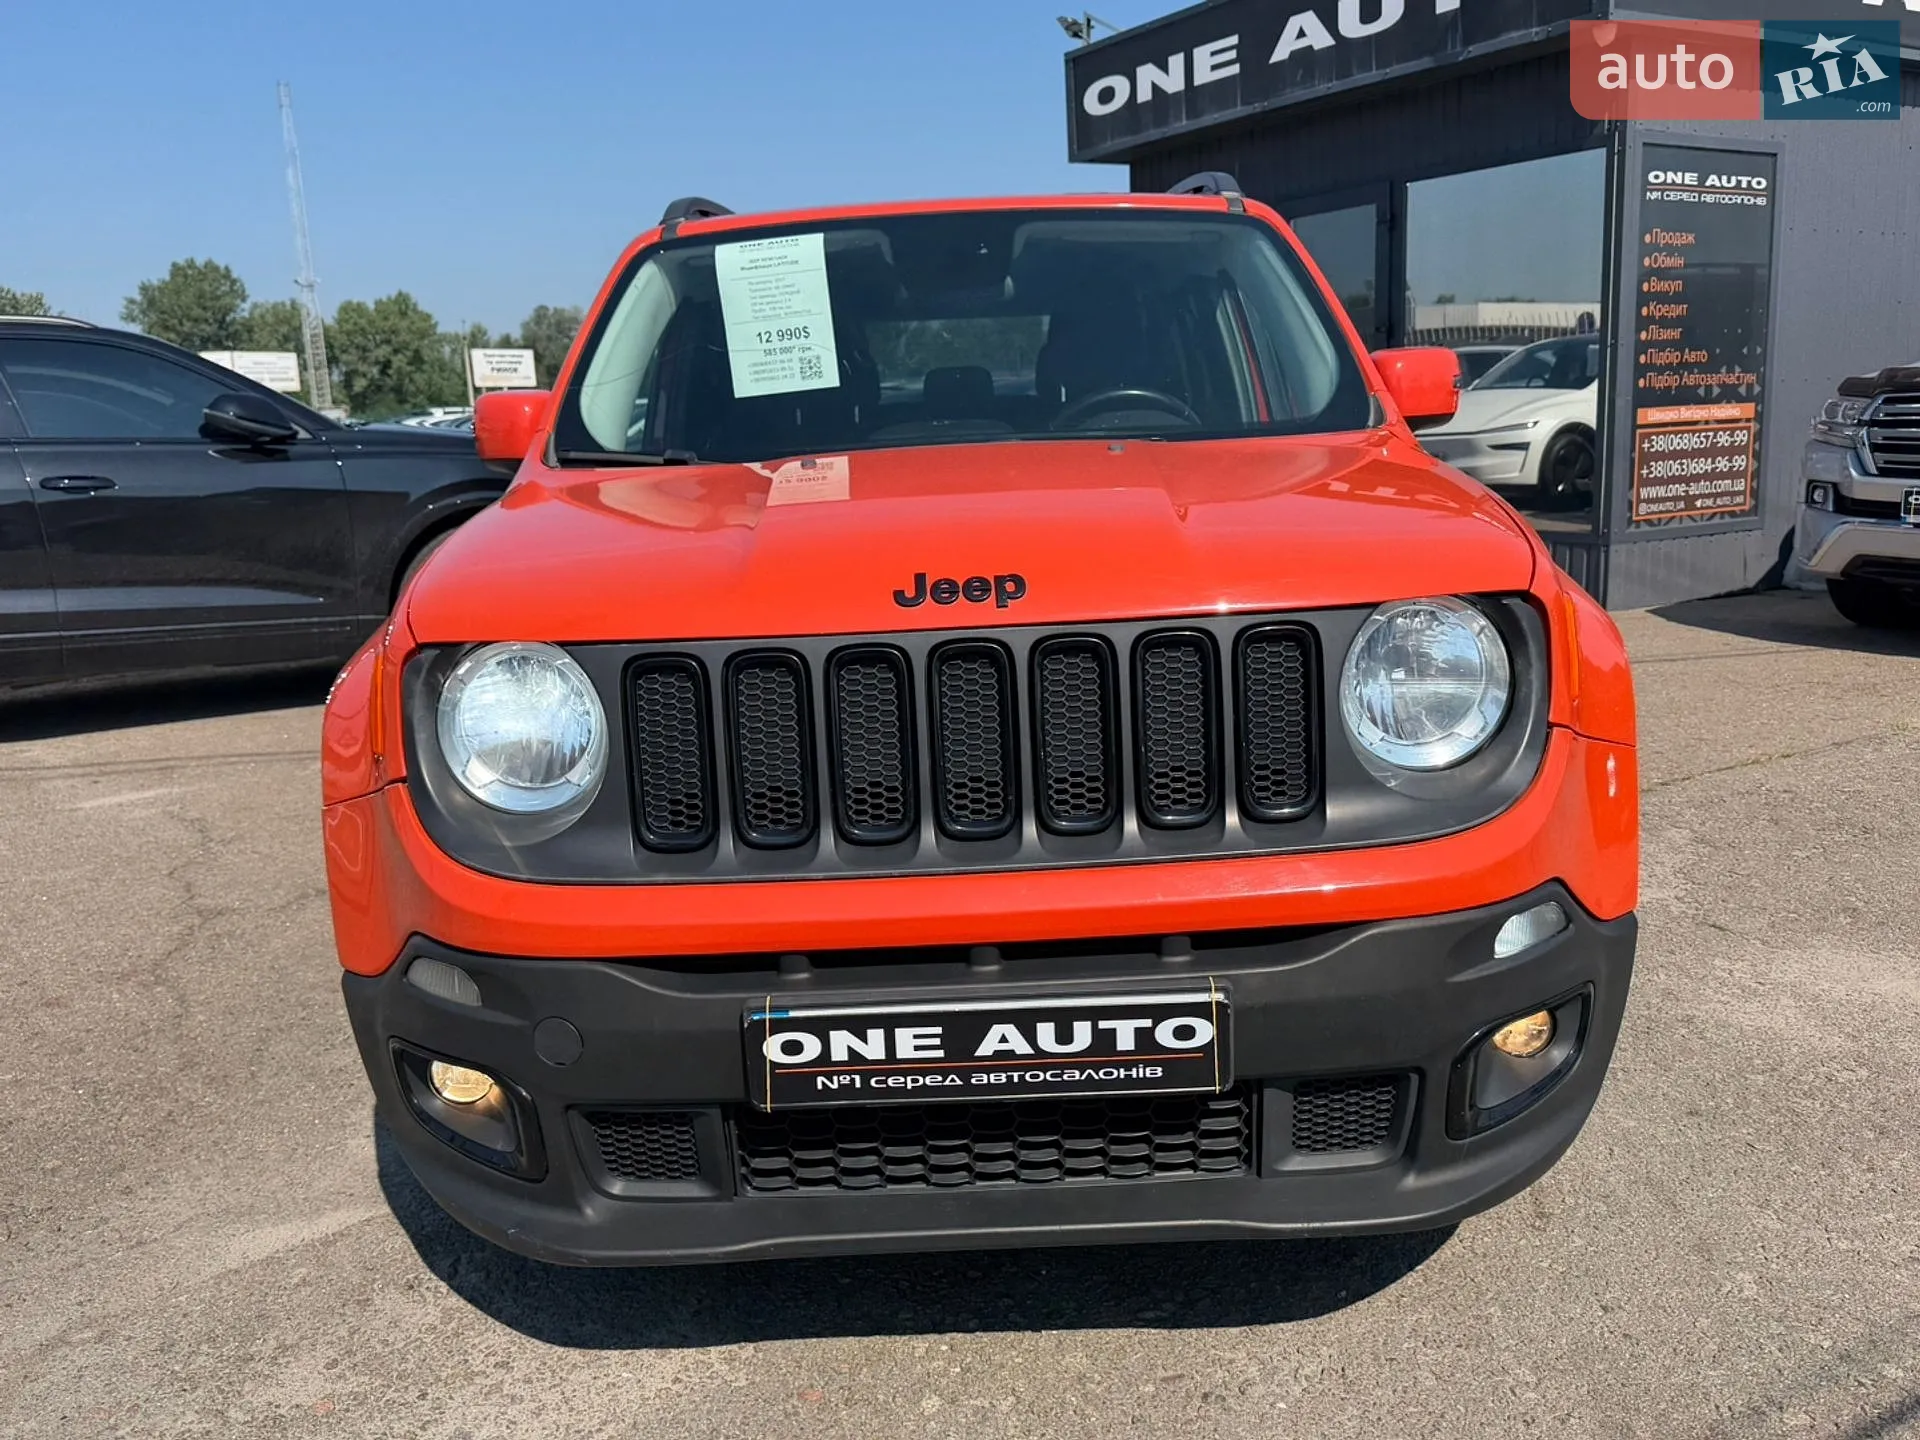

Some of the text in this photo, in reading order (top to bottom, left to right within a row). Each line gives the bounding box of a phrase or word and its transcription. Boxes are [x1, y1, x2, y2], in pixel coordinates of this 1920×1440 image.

[1082, 0, 1461, 117] ONE AU
[1647, 170, 1767, 190] ONE AUTO
[1652, 228, 1695, 247] Продаж
[1651, 252, 1685, 269] Обмін
[1650, 277, 1682, 296] Викуп
[1649, 301, 1689, 320] Кредит
[756, 325, 811, 344] 12 990$
[1647, 325, 1683, 341] Лізинг
[1646, 347, 1709, 366] Підбір Авто
[1646, 371, 1757, 391] Підбір Автозапчастин
[1641, 430, 1748, 453] +38(068)657-96-99
[1640, 454, 1747, 478] +38(063)684-96-99
[1639, 477, 1745, 499] www.one-auto.com.ua
[892, 572, 1027, 609] Jeep
[761, 1016, 1214, 1065] ONE AUTO
[816, 1063, 1164, 1091] №1 серед автосалонів
